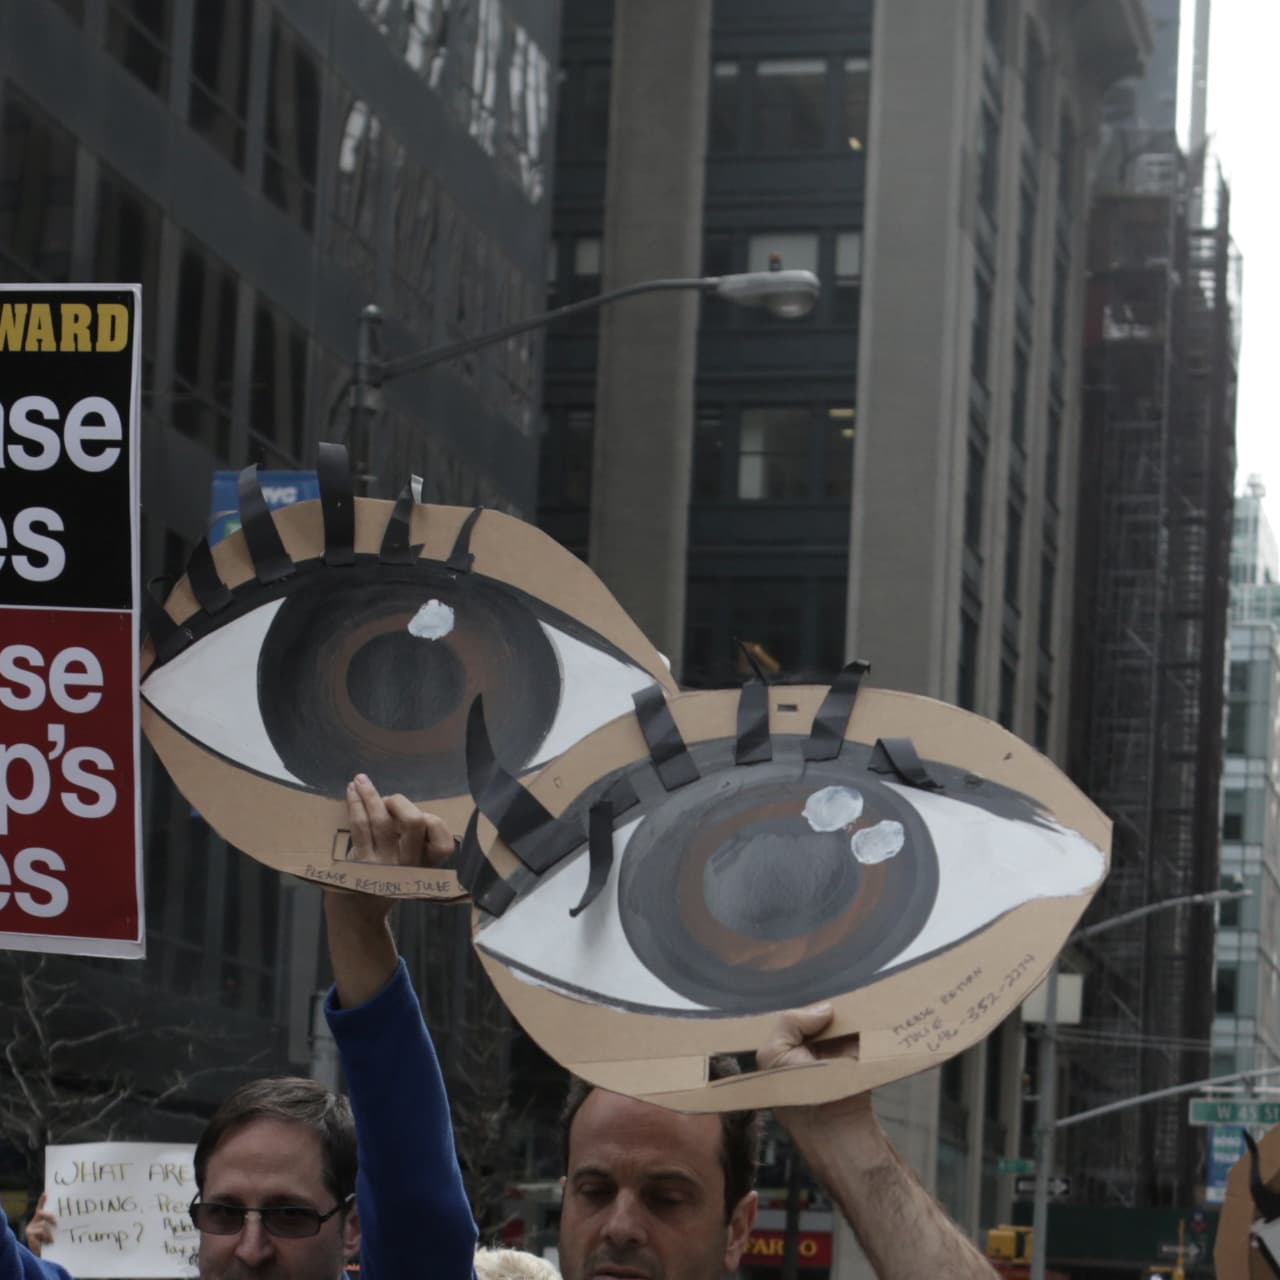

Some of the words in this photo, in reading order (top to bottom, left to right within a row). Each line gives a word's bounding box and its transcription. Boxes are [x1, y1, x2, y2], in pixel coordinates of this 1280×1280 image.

[1217, 1105, 1232, 1120] W
[1237, 1105, 1258, 1121] 45
[54, 1161, 135, 1186] WHAT
[148, 1161, 190, 1187] ARE
[68, 1222, 145, 1250] Trump?
[743, 1237, 819, 1258] FARO
